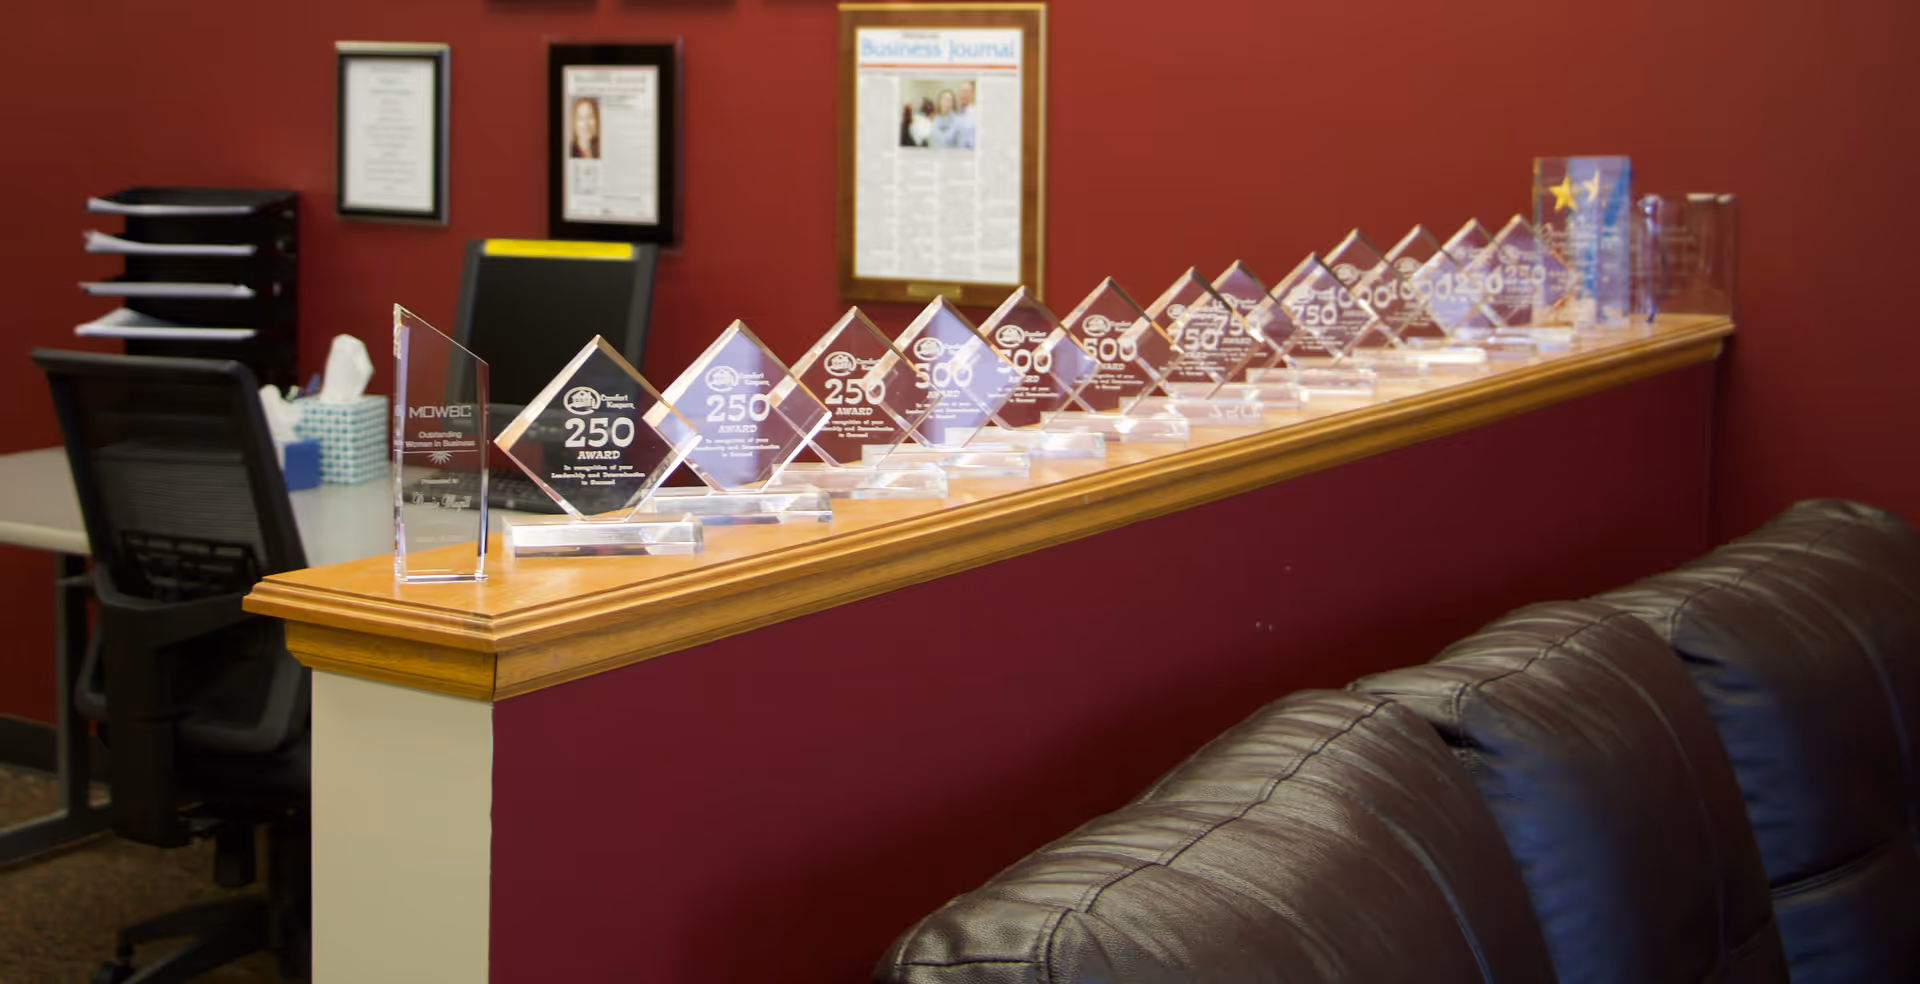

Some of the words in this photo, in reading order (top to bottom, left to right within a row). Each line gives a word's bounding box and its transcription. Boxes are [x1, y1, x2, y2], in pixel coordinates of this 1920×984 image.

[861, 38, 942, 58] Business
[947, 39, 1016, 62] Journal
[915, 362, 973, 388] 500
[824, 378, 886, 405] 250
[409, 405, 472, 418] MOWBC
[706, 394, 770, 422] 250
[835, 407, 873, 415] AWARD
[418, 431, 462, 439] Outstanding
[564, 417, 635, 448] 250
[718, 425, 757, 433] AWARD
[577, 450, 620, 460] AWARD
